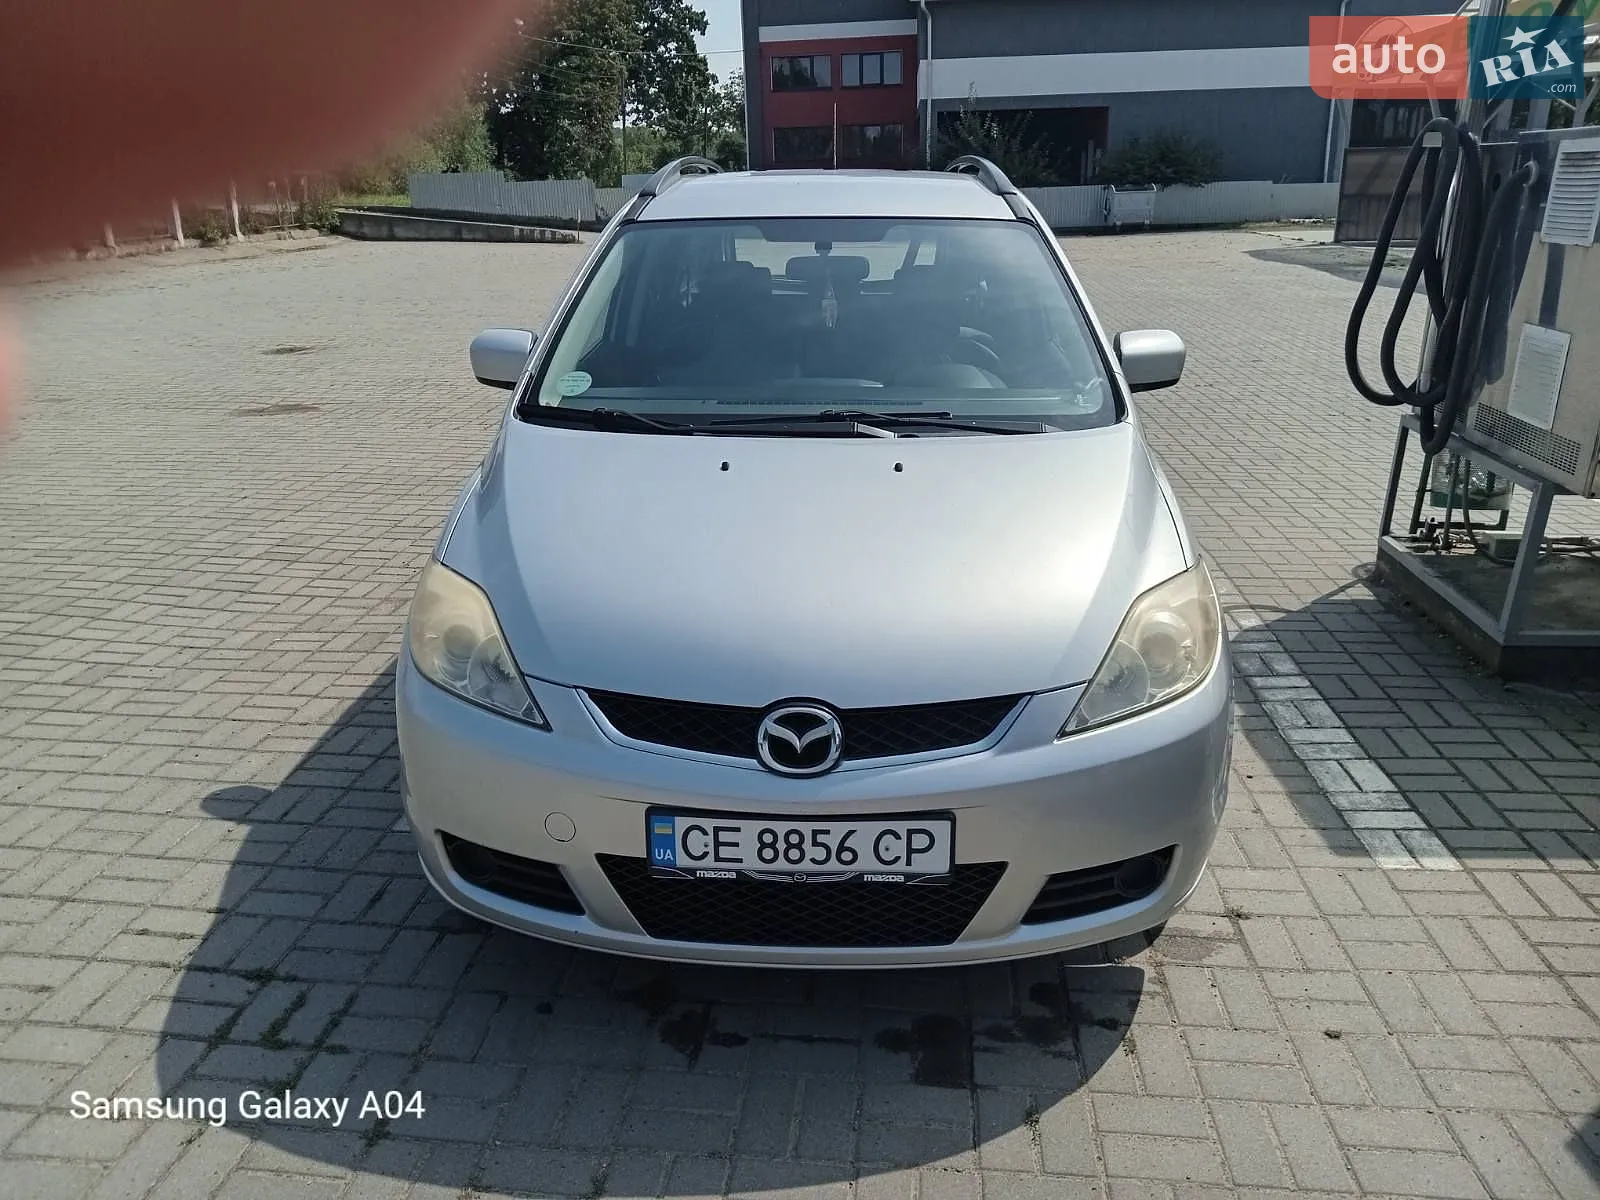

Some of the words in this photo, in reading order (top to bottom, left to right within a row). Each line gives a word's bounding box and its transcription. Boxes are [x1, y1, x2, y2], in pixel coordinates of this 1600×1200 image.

[681, 824, 744, 864] CE
[756, 827, 859, 866] 8856
[873, 828, 936, 867] CP
[655, 848, 674, 861] UA
[696, 870, 737, 879] mazda
[863, 873, 905, 883] mazda
